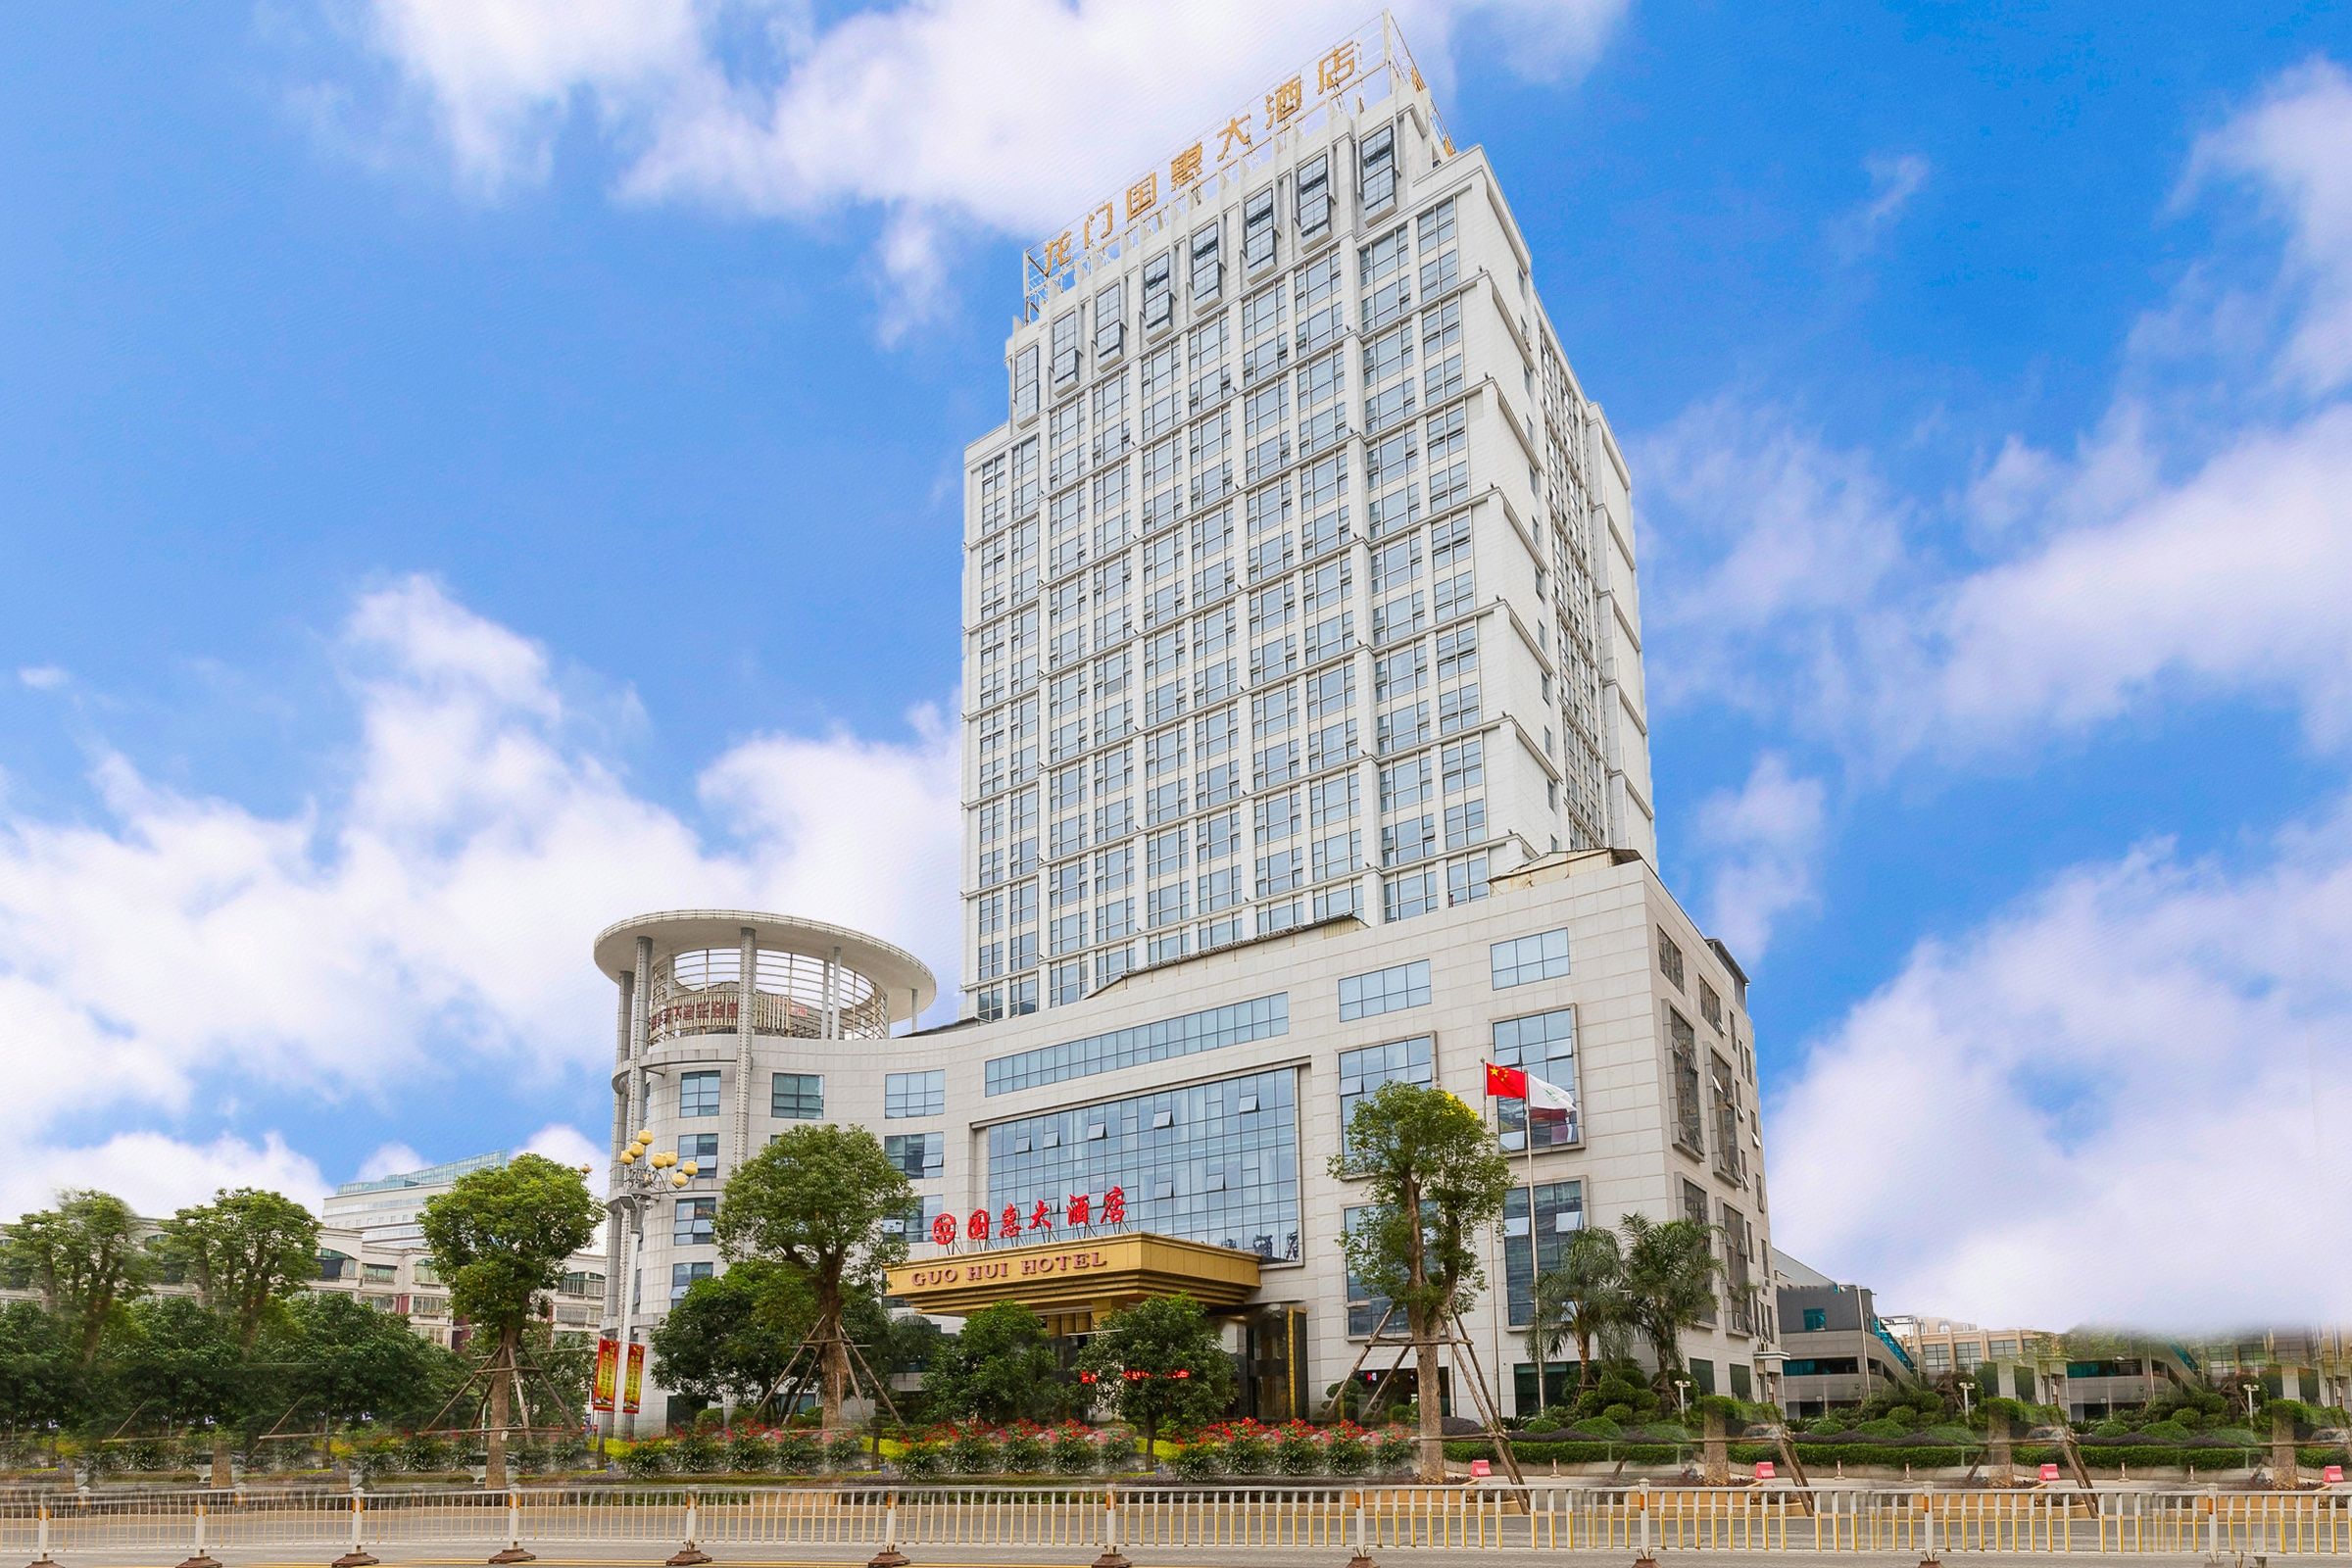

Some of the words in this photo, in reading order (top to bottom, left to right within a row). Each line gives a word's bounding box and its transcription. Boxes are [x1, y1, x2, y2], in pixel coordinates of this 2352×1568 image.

[911, 1269, 958, 1286] GUO
[967, 1263, 1008, 1281] HUI
[1022, 1252, 1106, 1274] HOTEL
